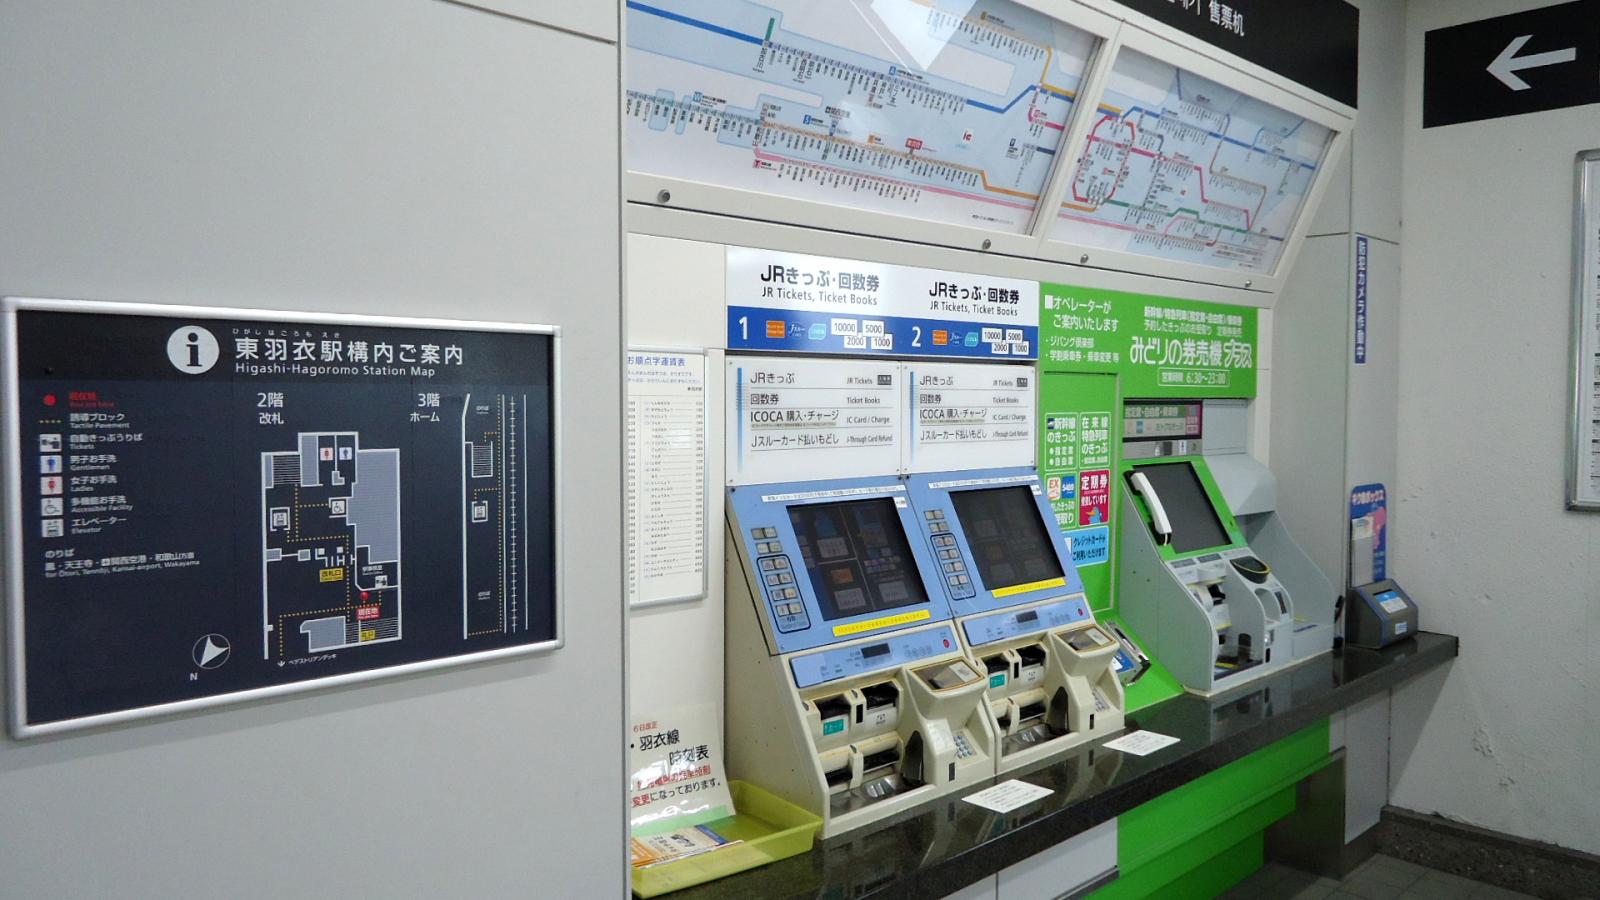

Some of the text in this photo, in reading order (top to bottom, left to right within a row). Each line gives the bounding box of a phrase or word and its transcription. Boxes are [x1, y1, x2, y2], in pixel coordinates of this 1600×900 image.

[761, 264, 880, 292] JRきっぷ・回数券
[762, 286, 878, 305] JR Tickets, Ticket Books
[929, 281, 1020, 305] JRきっぷ・回数券
[930, 300, 1018, 317] JR Tickets, Ticket Books
[1053, 296, 1112, 314] オペレーターが
[738, 316, 749, 341] 1
[834, 322, 856, 333] 10000
[865, 324, 883, 334] 5000
[1053, 314, 1119, 332] ご案内いたします
[847, 337, 891, 347] 2000 1000
[911, 326, 1022, 348] 2 10000 5000
[234, 337, 464, 365] 東羽衣駅構内ご案内
[994, 343, 1028, 353] 2000 1000
[235, 363, 436, 379] Higashi-Hagoromo Station Map
[750, 372, 795, 385] JRきっぷ
[855, 377, 873, 385] Tickets
[919, 375, 954, 386] JRきっぷ
[257, 392, 285, 408] 2階
[417, 393, 441, 408] 3階
[750, 393, 780, 406] 回数券
[919, 393, 942, 404] 回数券
[258, 412, 285, 425] 改札
[409, 411, 441, 423] ホーム
[750, 410, 840, 423] ICOCA 購入・チャージ
[847, 416, 853, 424] IC
[854, 415, 867, 424] Card
[871, 415, 890, 426] Charge
[919, 409, 945, 419] ICOCA
[70, 432, 144, 443] 自動きっぷうりば
[751, 433, 840, 448] Jスルーカード払いもどし
[1047, 431, 1076, 443] のきっぷ
[1081, 442, 1108, 455] のきっぷ
[1081, 473, 1108, 491] 定期券
[71, 485, 94, 493] Ladies
[71, 516, 128, 528] エレベーター
[45, 548, 76, 559] のりば
[190, 672, 198, 681] N
[668, 743, 710, 766] 時刻表
